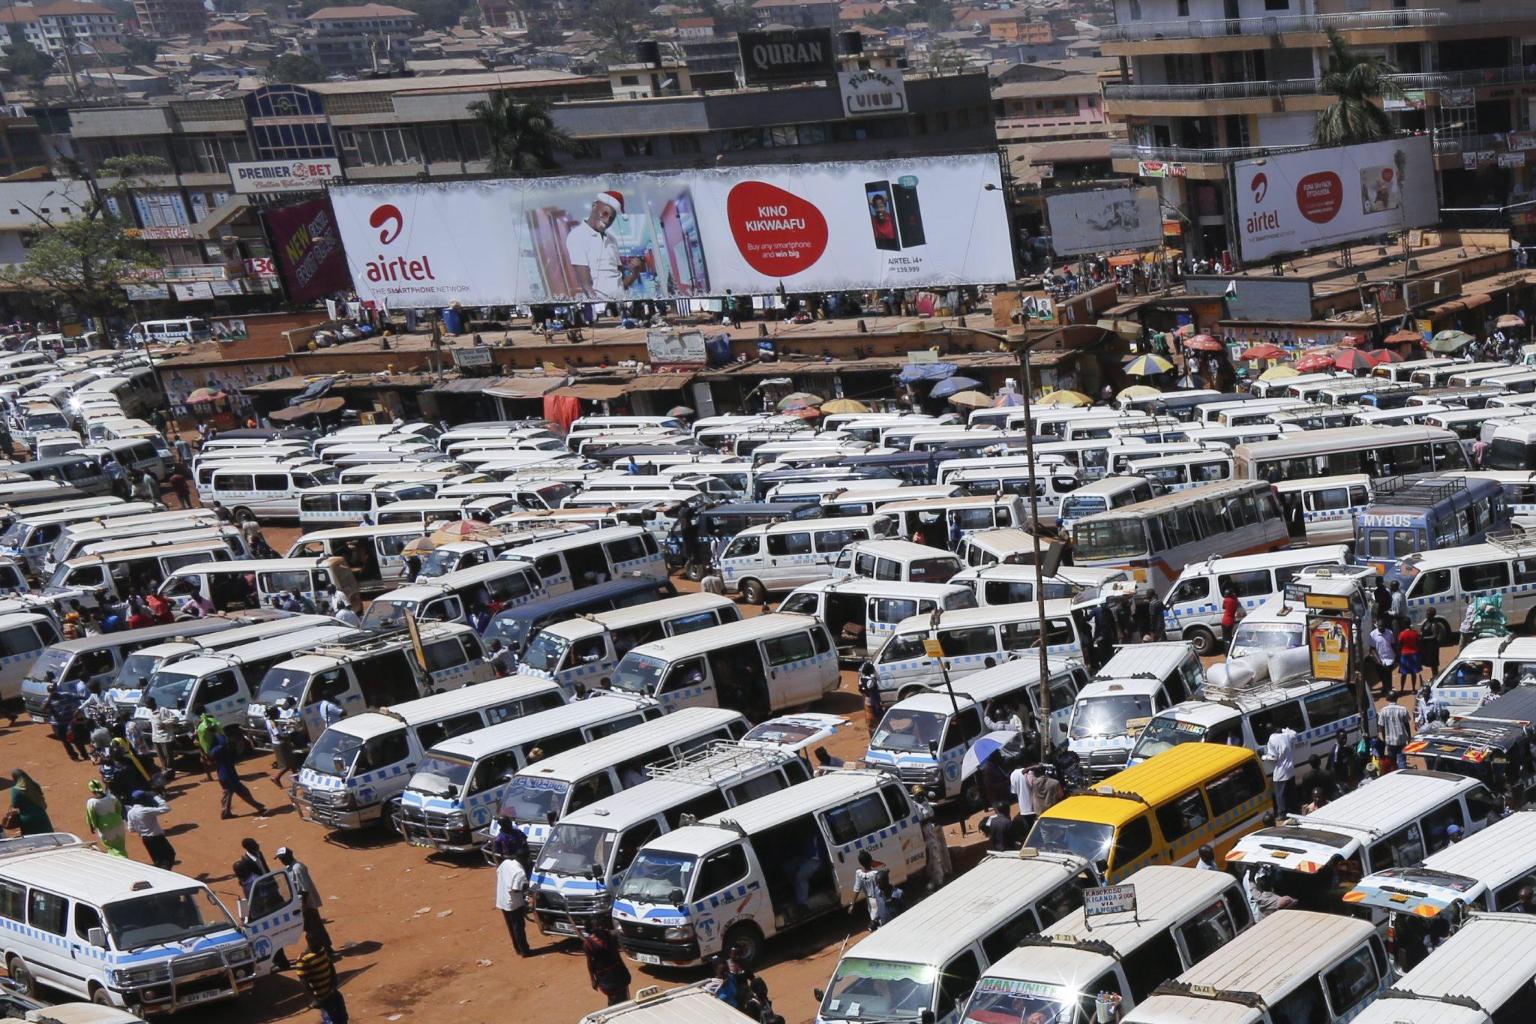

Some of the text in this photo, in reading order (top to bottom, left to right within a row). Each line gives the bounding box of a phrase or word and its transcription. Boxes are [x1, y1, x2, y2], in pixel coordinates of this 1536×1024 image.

[753, 41, 823, 70] QURAN
[849, 71, 895, 88] Pioneer
[238, 164, 332, 180] PREMIER BET
[757, 205, 788, 218] KINO
[745, 218, 806, 232] KIKWAAFU
[1246, 210, 1280, 234] airtel
[285, 224, 311, 266] NEW
[747, 241, 813, 251] Buy any smartphone
[762, 249, 800, 259] and win big
[888, 257, 911, 265] AIRTEL
[366, 254, 435, 282] airtel
[372, 285, 470, 295] THE SMARTPHONE NETWORK
[1363, 514, 1411, 527] MYBUS
[982, 979, 1012, 996] MAN
